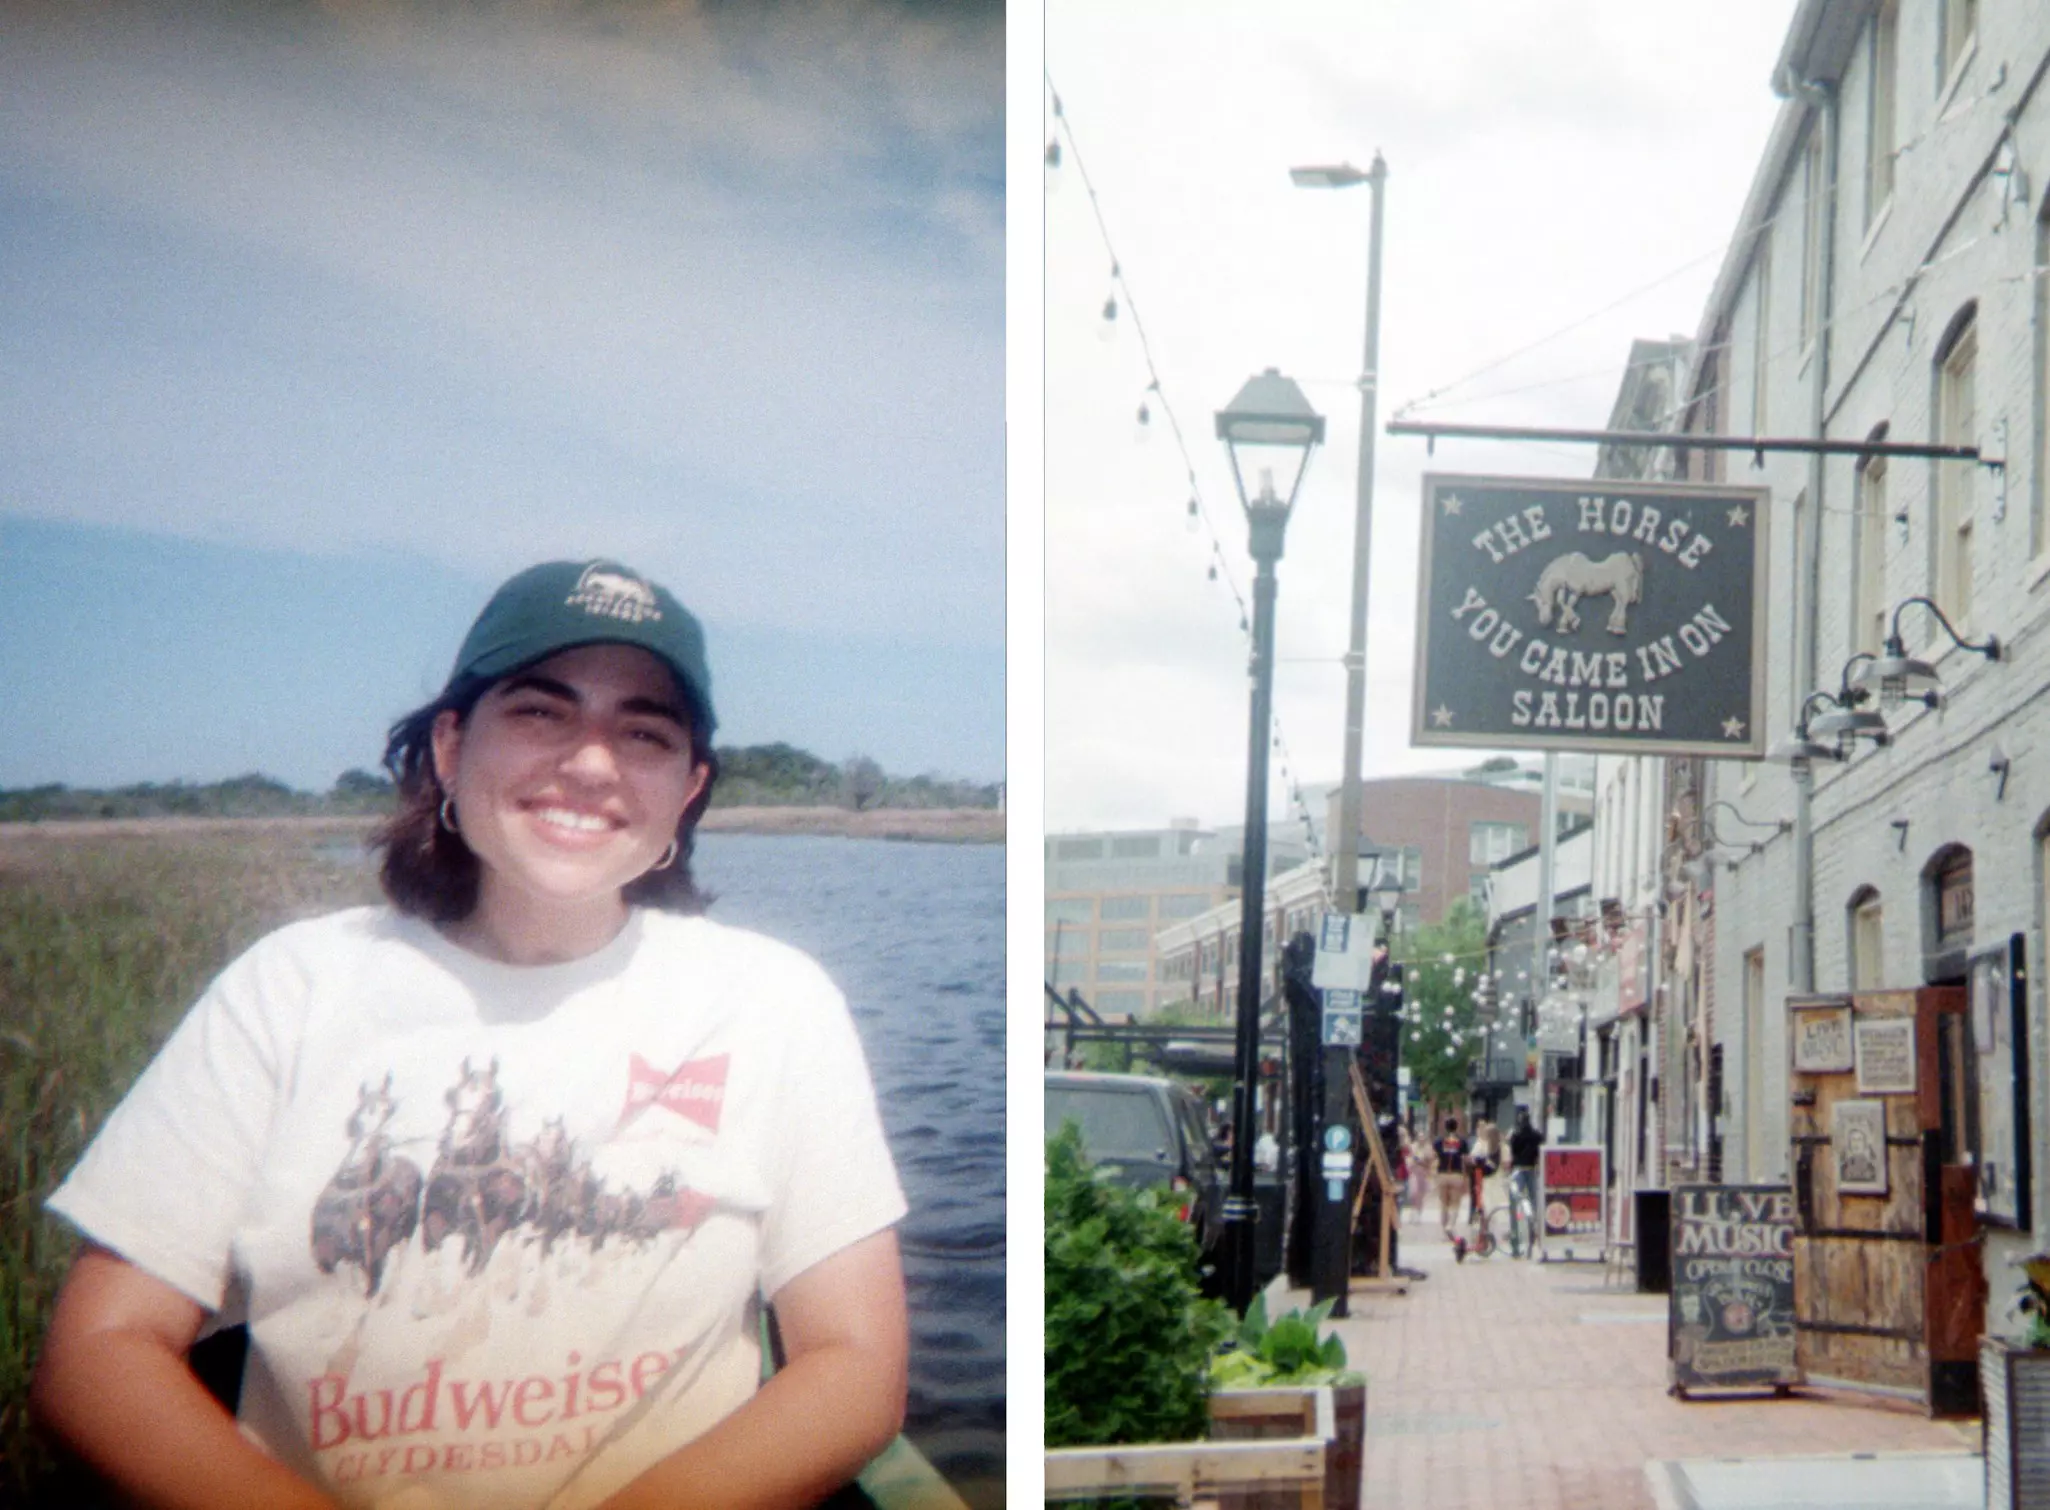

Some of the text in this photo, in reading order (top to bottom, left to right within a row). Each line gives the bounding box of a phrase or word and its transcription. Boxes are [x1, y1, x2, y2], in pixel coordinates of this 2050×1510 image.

[1472, 497, 1714, 569] THE HORSE
[1451, 587, 1732, 688] YOU CAME IN ON
[1511, 691, 1664, 731] SALOON
[1676, 1223, 1795, 1256] MUSIC
[306, 1346, 690, 1453] Budweise
